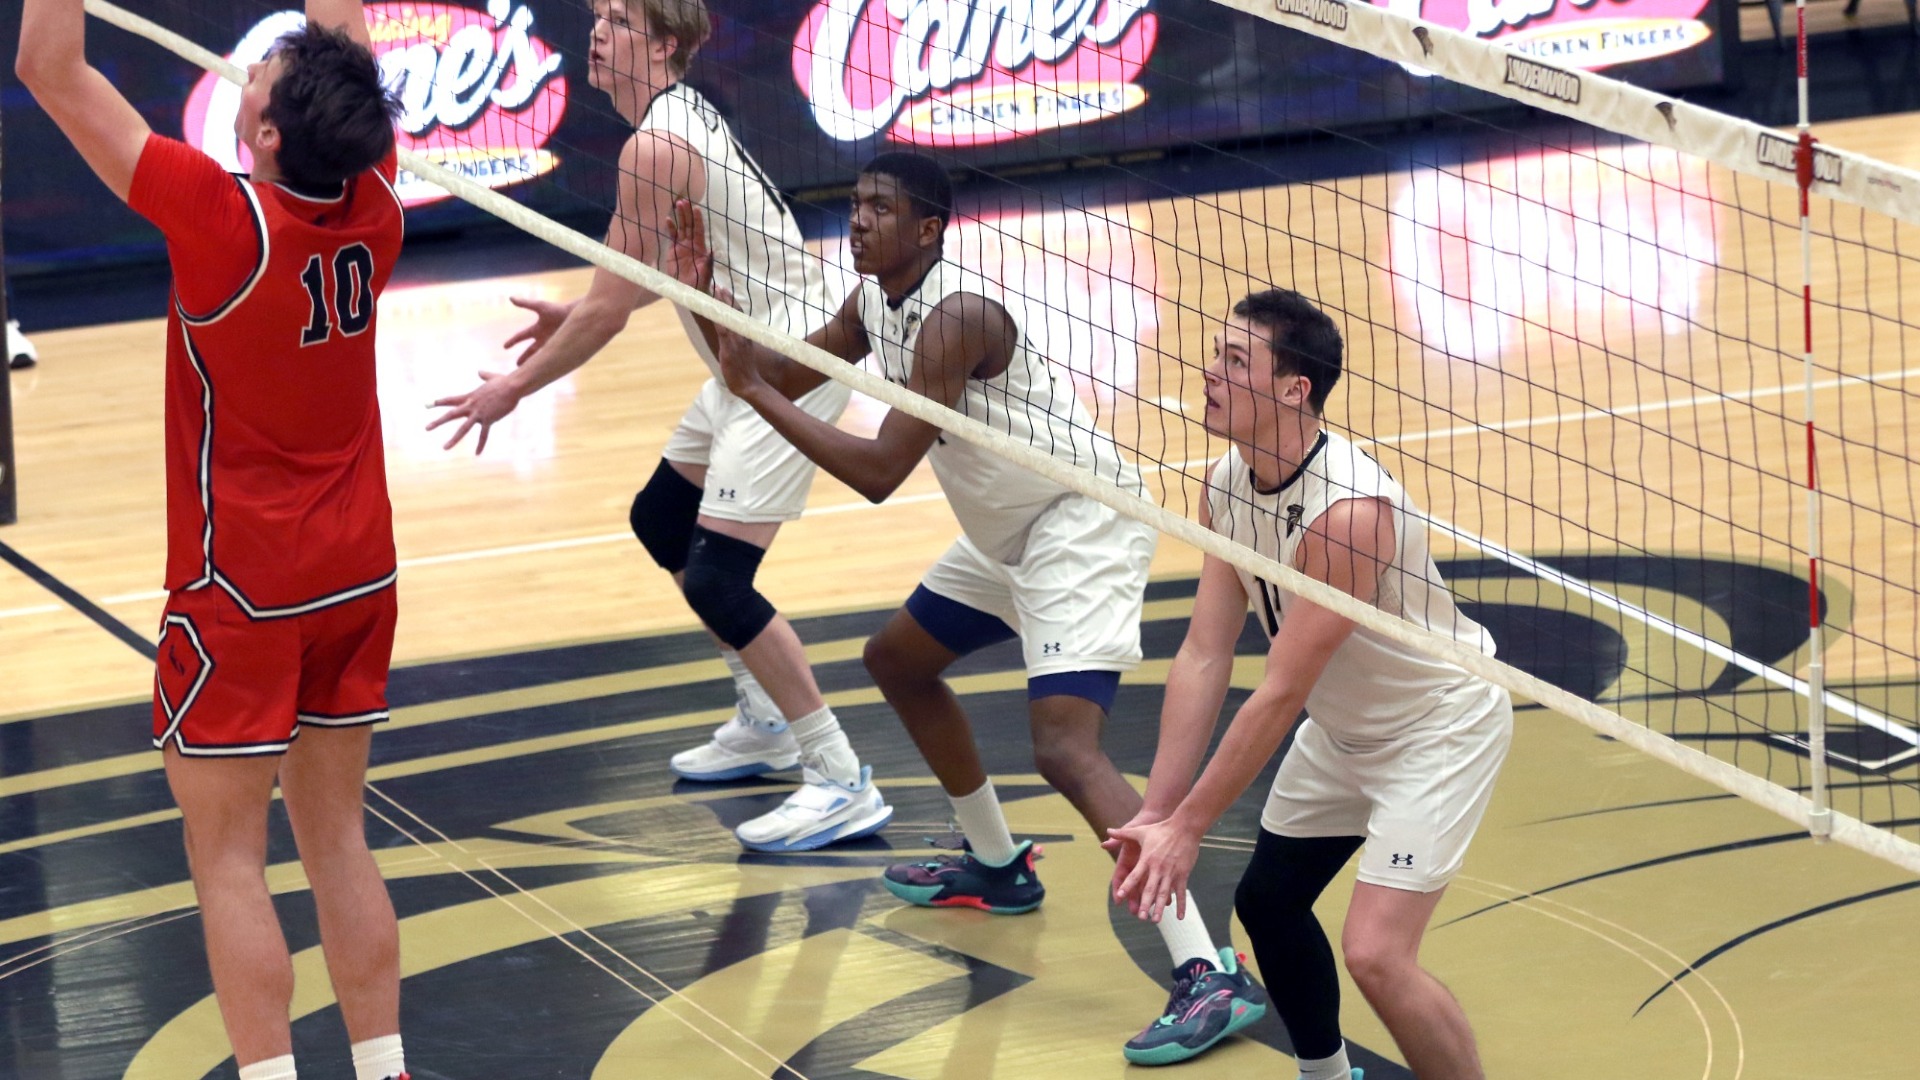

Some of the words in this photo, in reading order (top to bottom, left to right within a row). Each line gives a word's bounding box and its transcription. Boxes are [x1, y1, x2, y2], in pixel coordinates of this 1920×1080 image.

[1601, 26, 1686, 50] FINGERS
[810, 0, 1160, 141] Cane
[931, 102, 1021, 126] CHICKEN
[1034, 89, 1121, 114] FINGERS
[1757, 132, 1842, 185] LINDEOOD
[300, 241, 375, 348] 10
